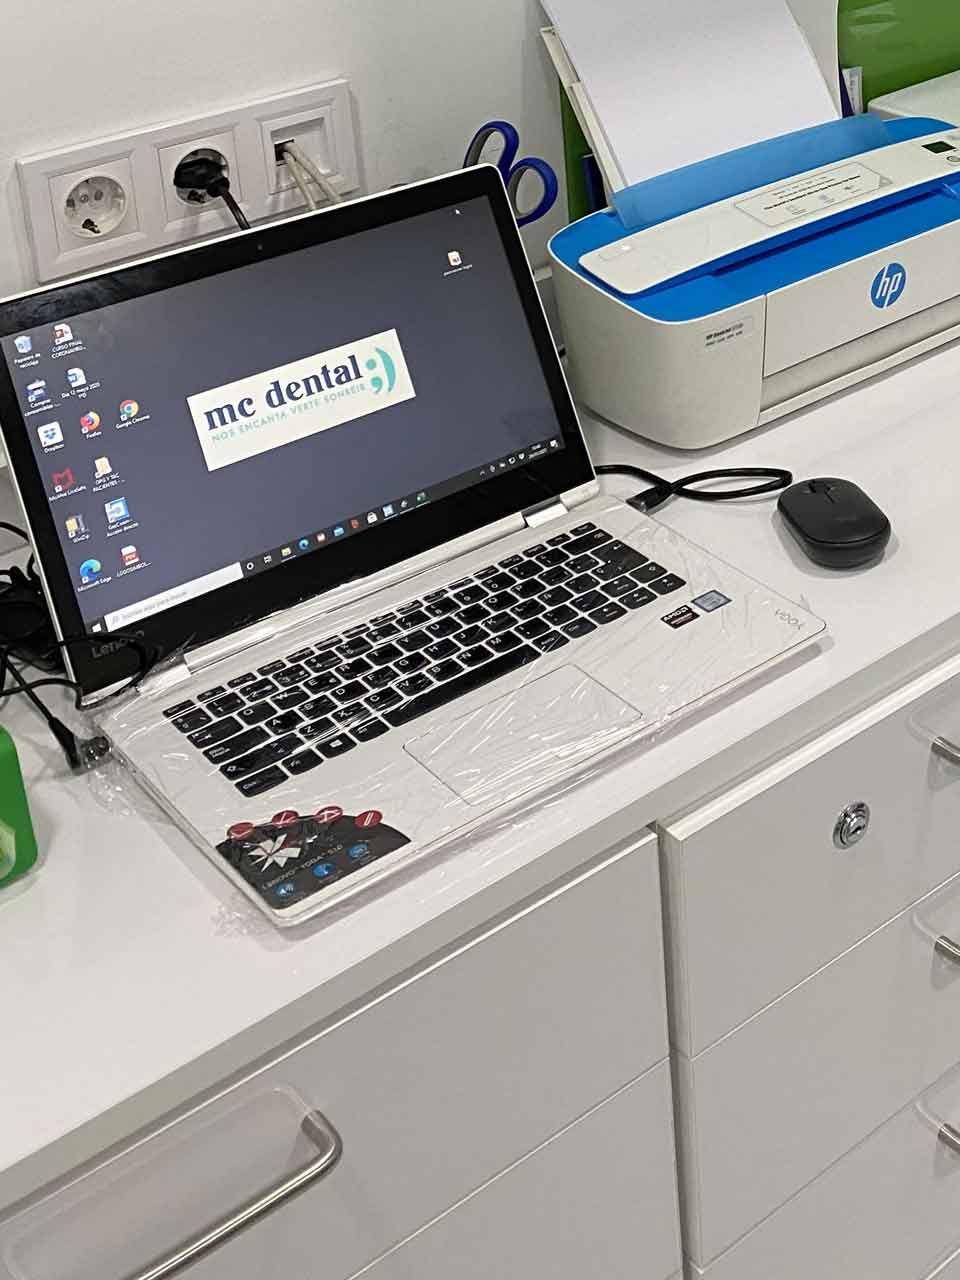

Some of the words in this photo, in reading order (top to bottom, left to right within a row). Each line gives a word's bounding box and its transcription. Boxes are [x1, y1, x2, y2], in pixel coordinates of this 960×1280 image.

[874, 265, 902, 308] hp
[203, 396, 257, 431] mc
[265, 355, 364, 409] dental
[92, 630, 145, 658] Lenoo
